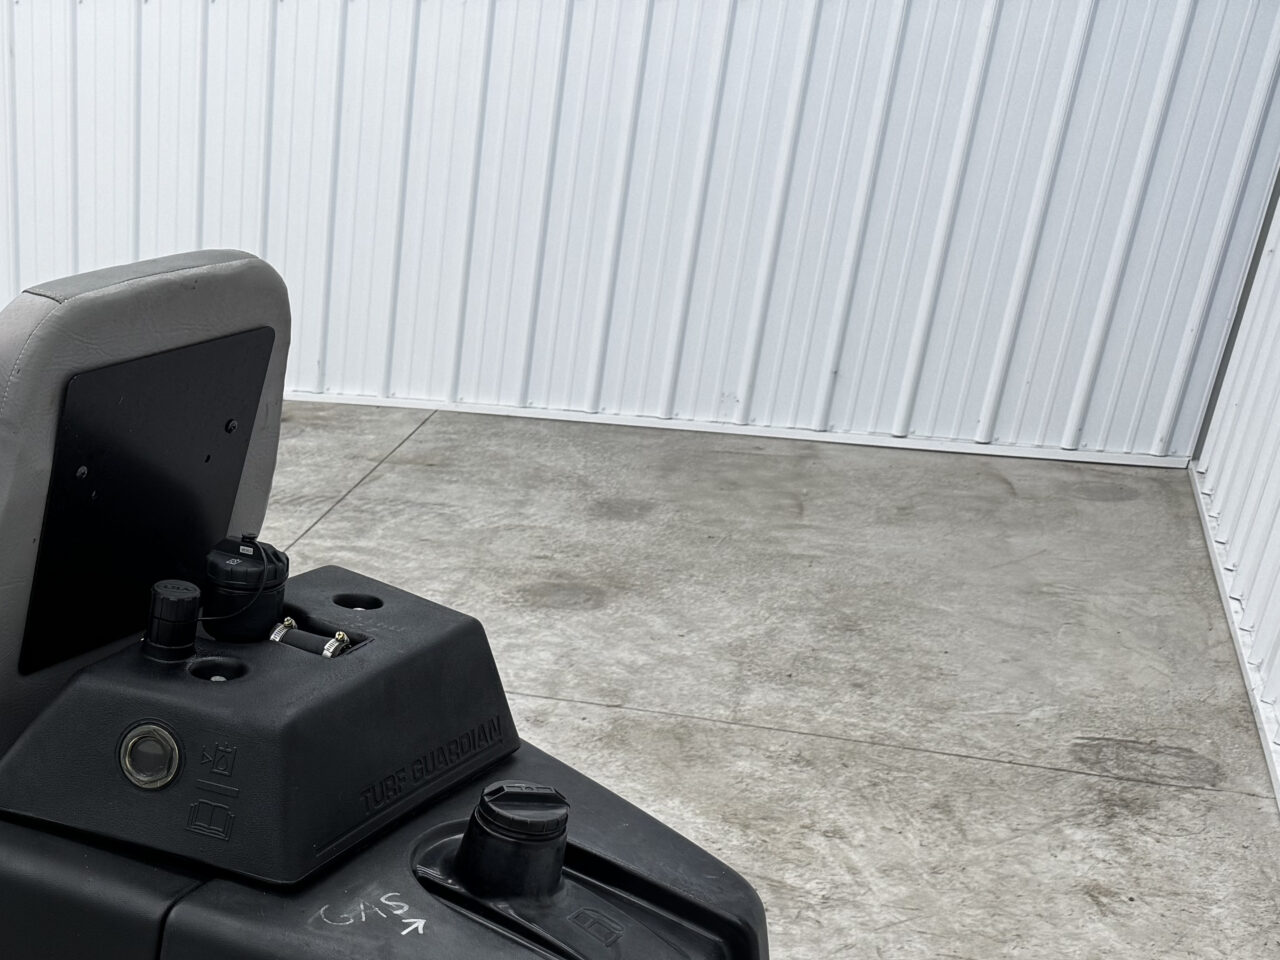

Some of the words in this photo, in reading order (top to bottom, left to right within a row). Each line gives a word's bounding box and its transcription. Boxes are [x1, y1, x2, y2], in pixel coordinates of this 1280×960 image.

[360, 767, 406, 812] TURF
[411, 715, 503, 784] GUARDIAN
[320, 892, 409, 925] GAS
